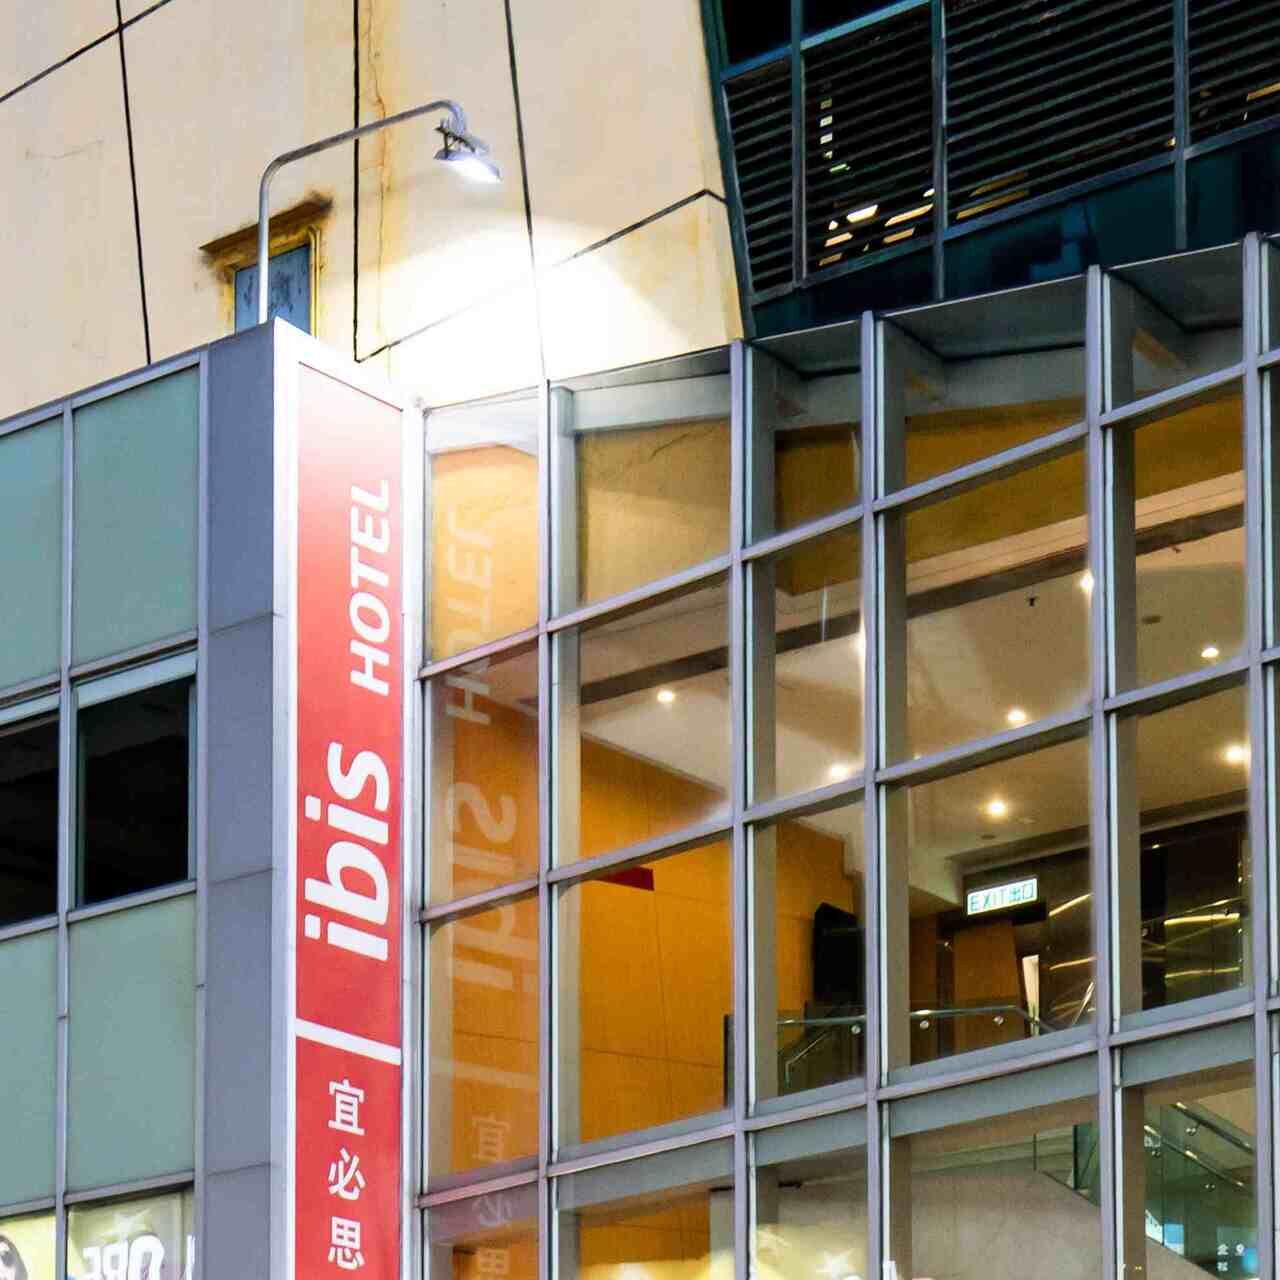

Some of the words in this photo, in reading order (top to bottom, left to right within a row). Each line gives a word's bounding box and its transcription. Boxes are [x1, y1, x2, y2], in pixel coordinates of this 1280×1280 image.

[305, 742, 390, 962] ibis
[349, 479, 390, 697] HOTEL
[970, 888, 1007, 912] EXIT
